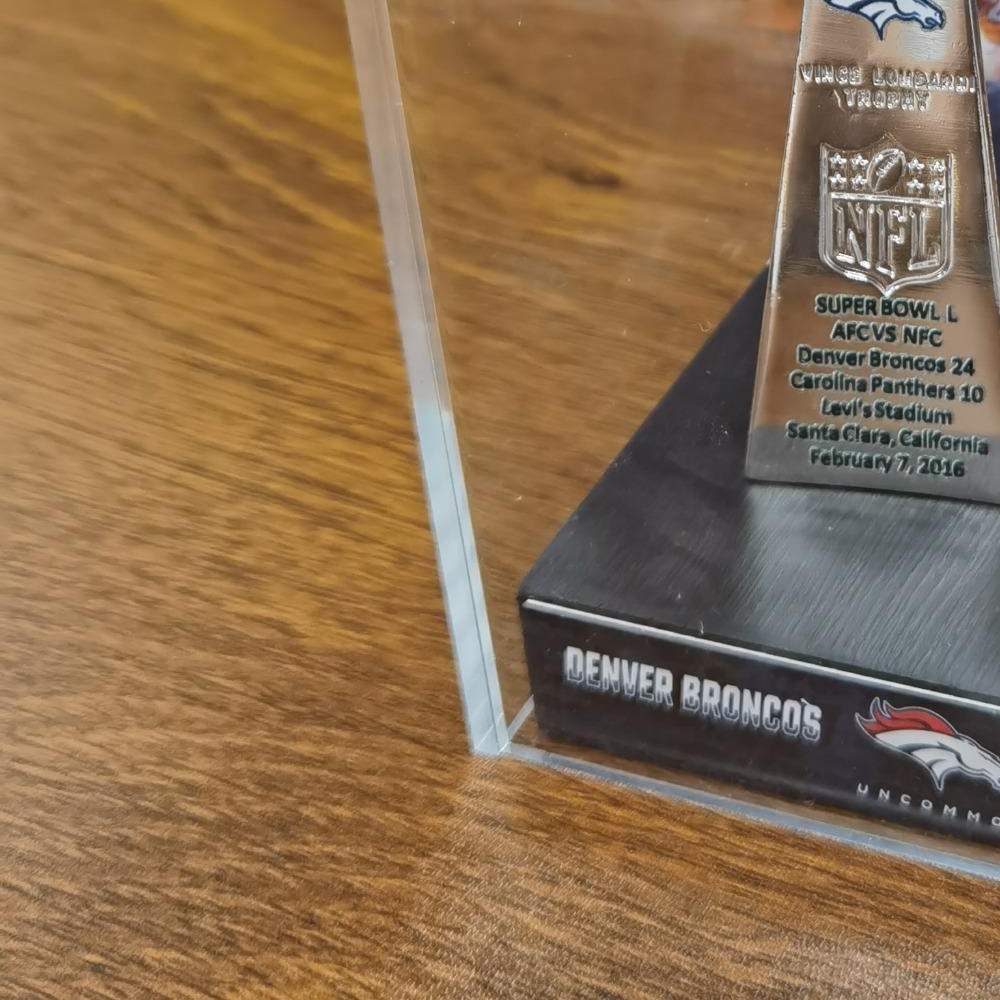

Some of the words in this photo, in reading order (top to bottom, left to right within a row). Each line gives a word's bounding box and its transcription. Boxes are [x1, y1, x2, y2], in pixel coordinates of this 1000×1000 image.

[800, 64, 861, 86] VINCE
[834, 202, 941, 279] NFL
[815, 294, 877, 316] SUPER
[881, 297, 940, 321] BOWL
[946, 304, 959, 323] L
[831, 321, 869, 342] AFC
[872, 323, 897, 343] VS
[903, 325, 943, 348] NFC
[797, 344, 866, 368] Denver
[869, 348, 946, 375] Broncos
[950, 356, 976, 378] 24
[790, 371, 868, 393] Carolina
[870, 375, 955, 402] Panthers
[959, 384, 985, 404] 10
[820, 397, 872, 419] Levi's
[874, 399, 954, 426] Stadium
[786, 420, 841, 443] Santa
[842, 423, 897, 448] Clara,
[898, 429, 989, 456] California
[809, 446, 893, 473] February
[896, 453, 913, 476] 7,
[916, 456, 966, 479] 2016
[563, 645, 674, 708] DENVER
[680, 673, 822, 742] BRONCOS
